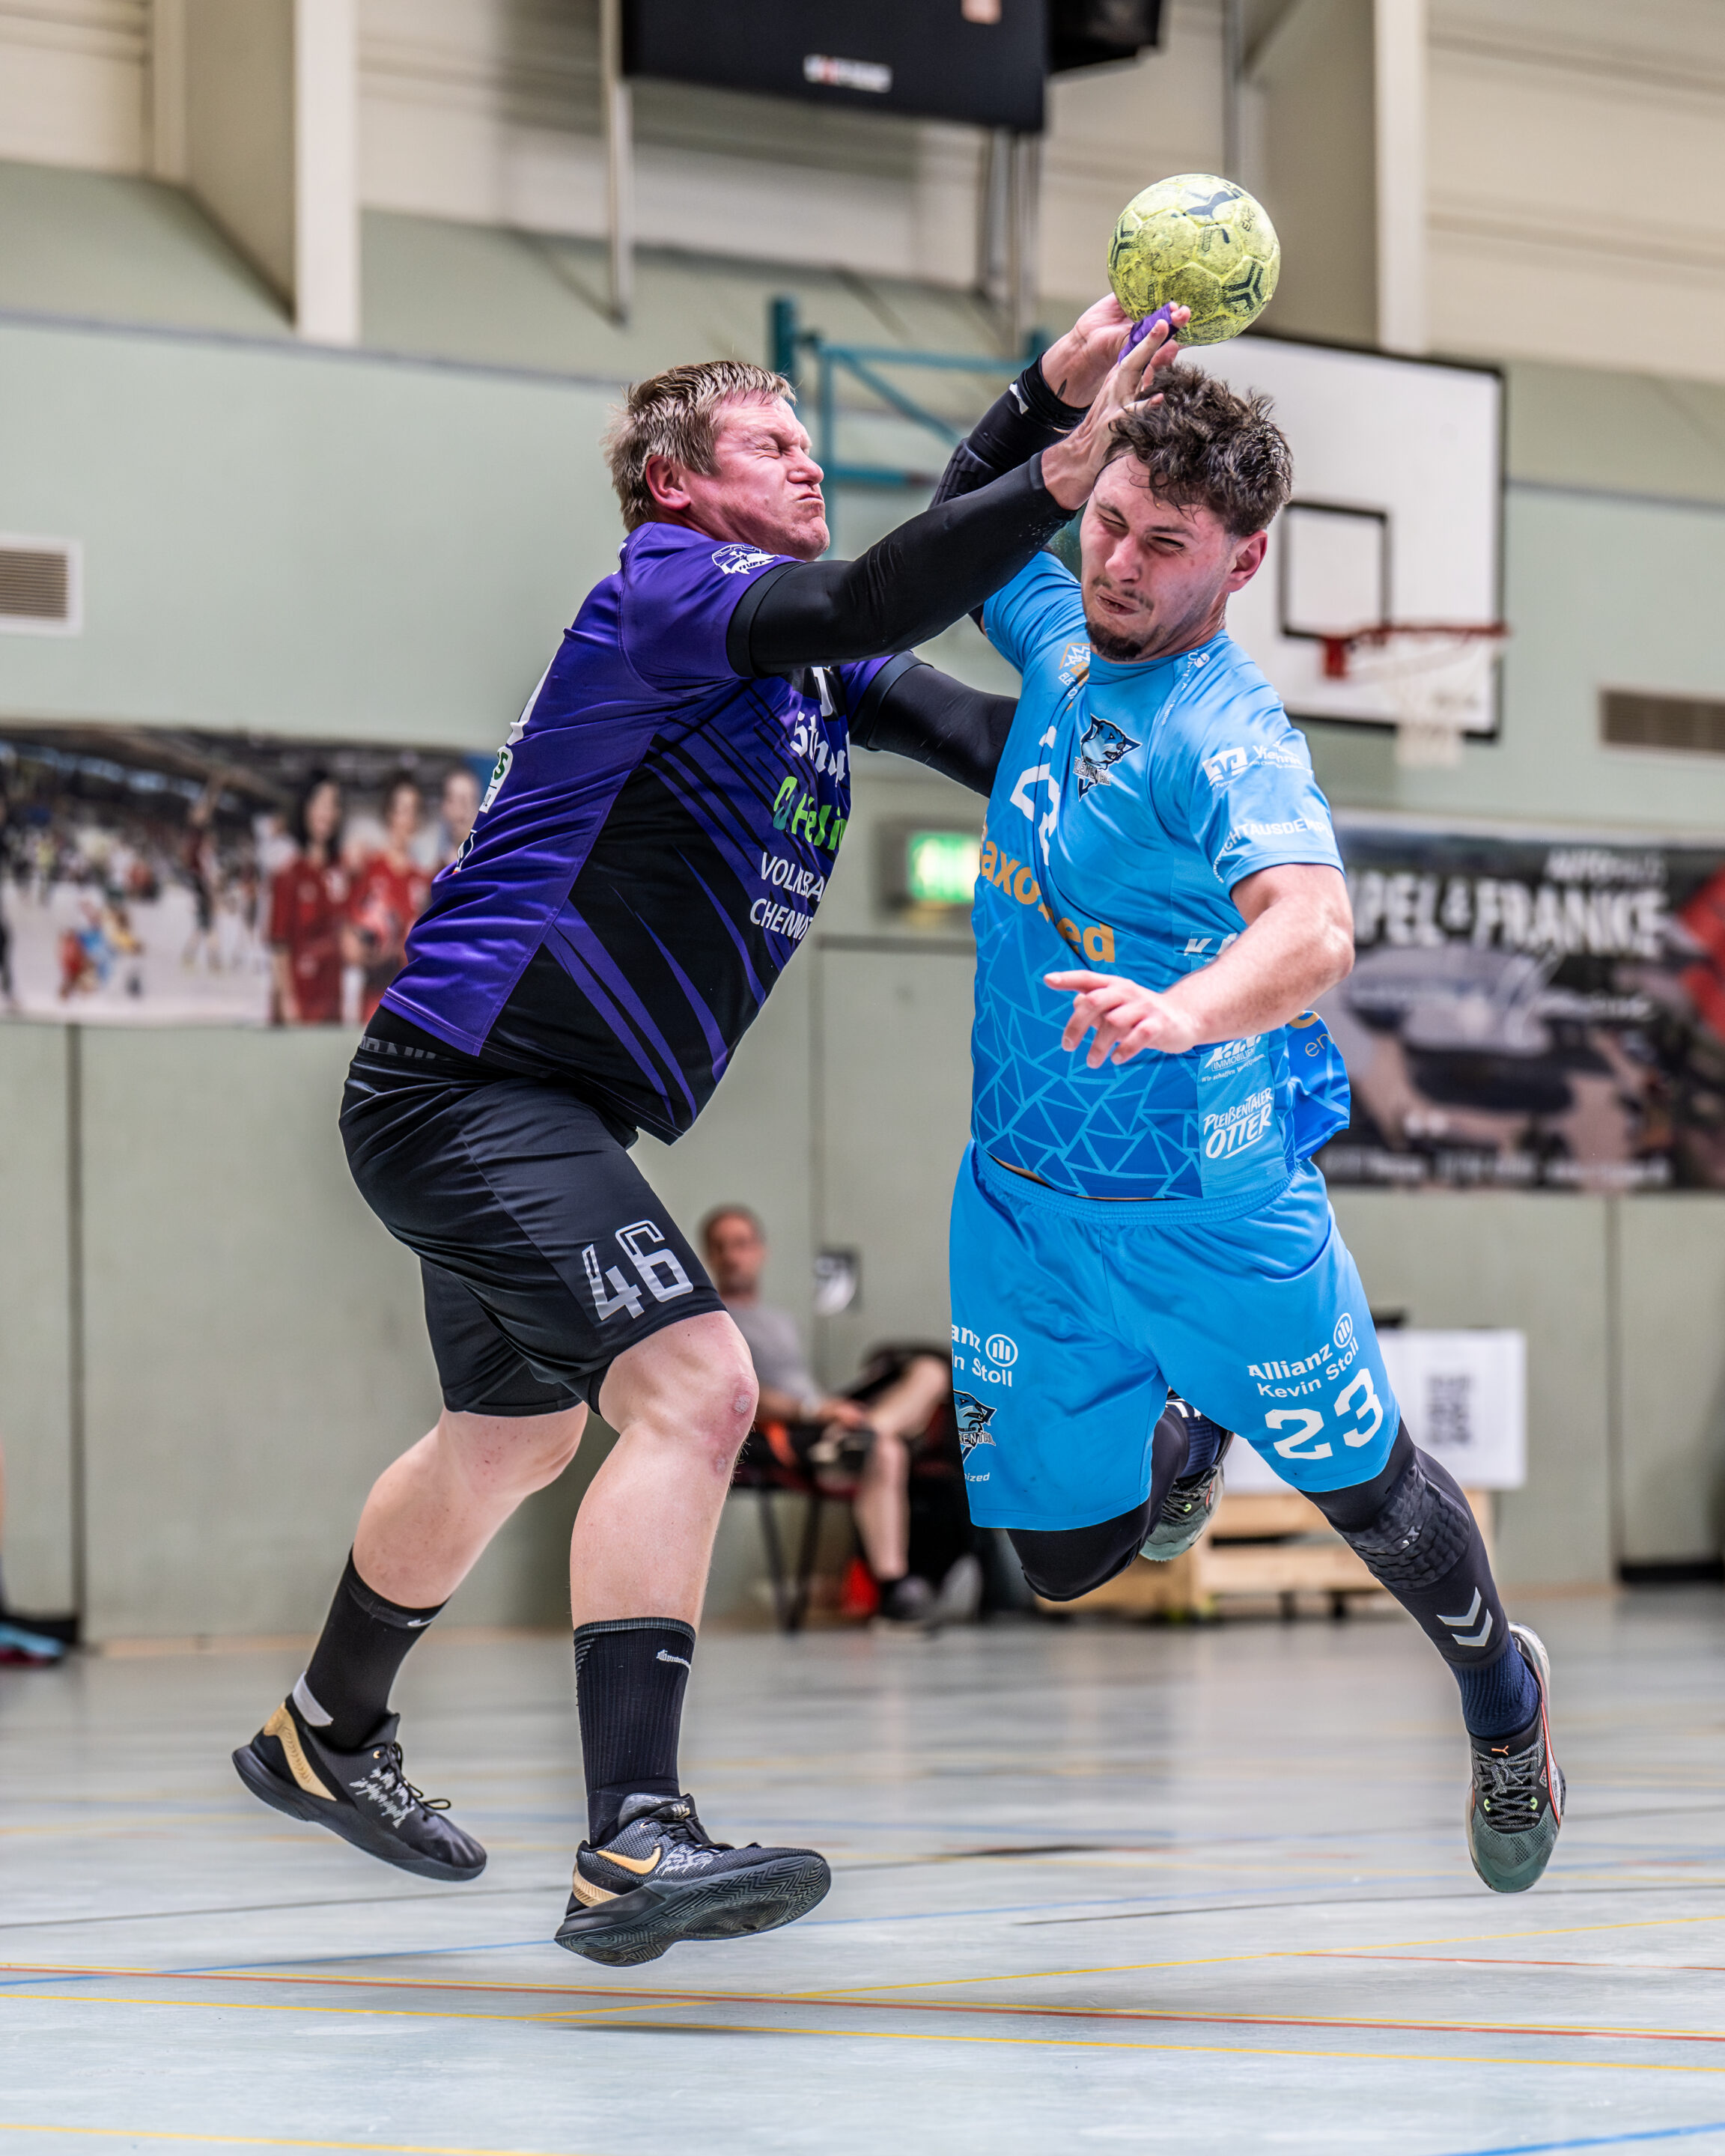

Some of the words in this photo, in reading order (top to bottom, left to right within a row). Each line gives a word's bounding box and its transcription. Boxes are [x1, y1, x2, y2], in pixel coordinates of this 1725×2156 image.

[1205, 1103, 1272, 1159] OTTER
[581, 1219, 693, 1321] 46
[972, 1357, 1012, 1387] Stoll
[1247, 1343, 1333, 1380] Allianz
[1256, 1378, 1321, 1398] Kevin
[1325, 1336, 1359, 1380] Stoll
[1265, 1368, 1384, 1460] 23
